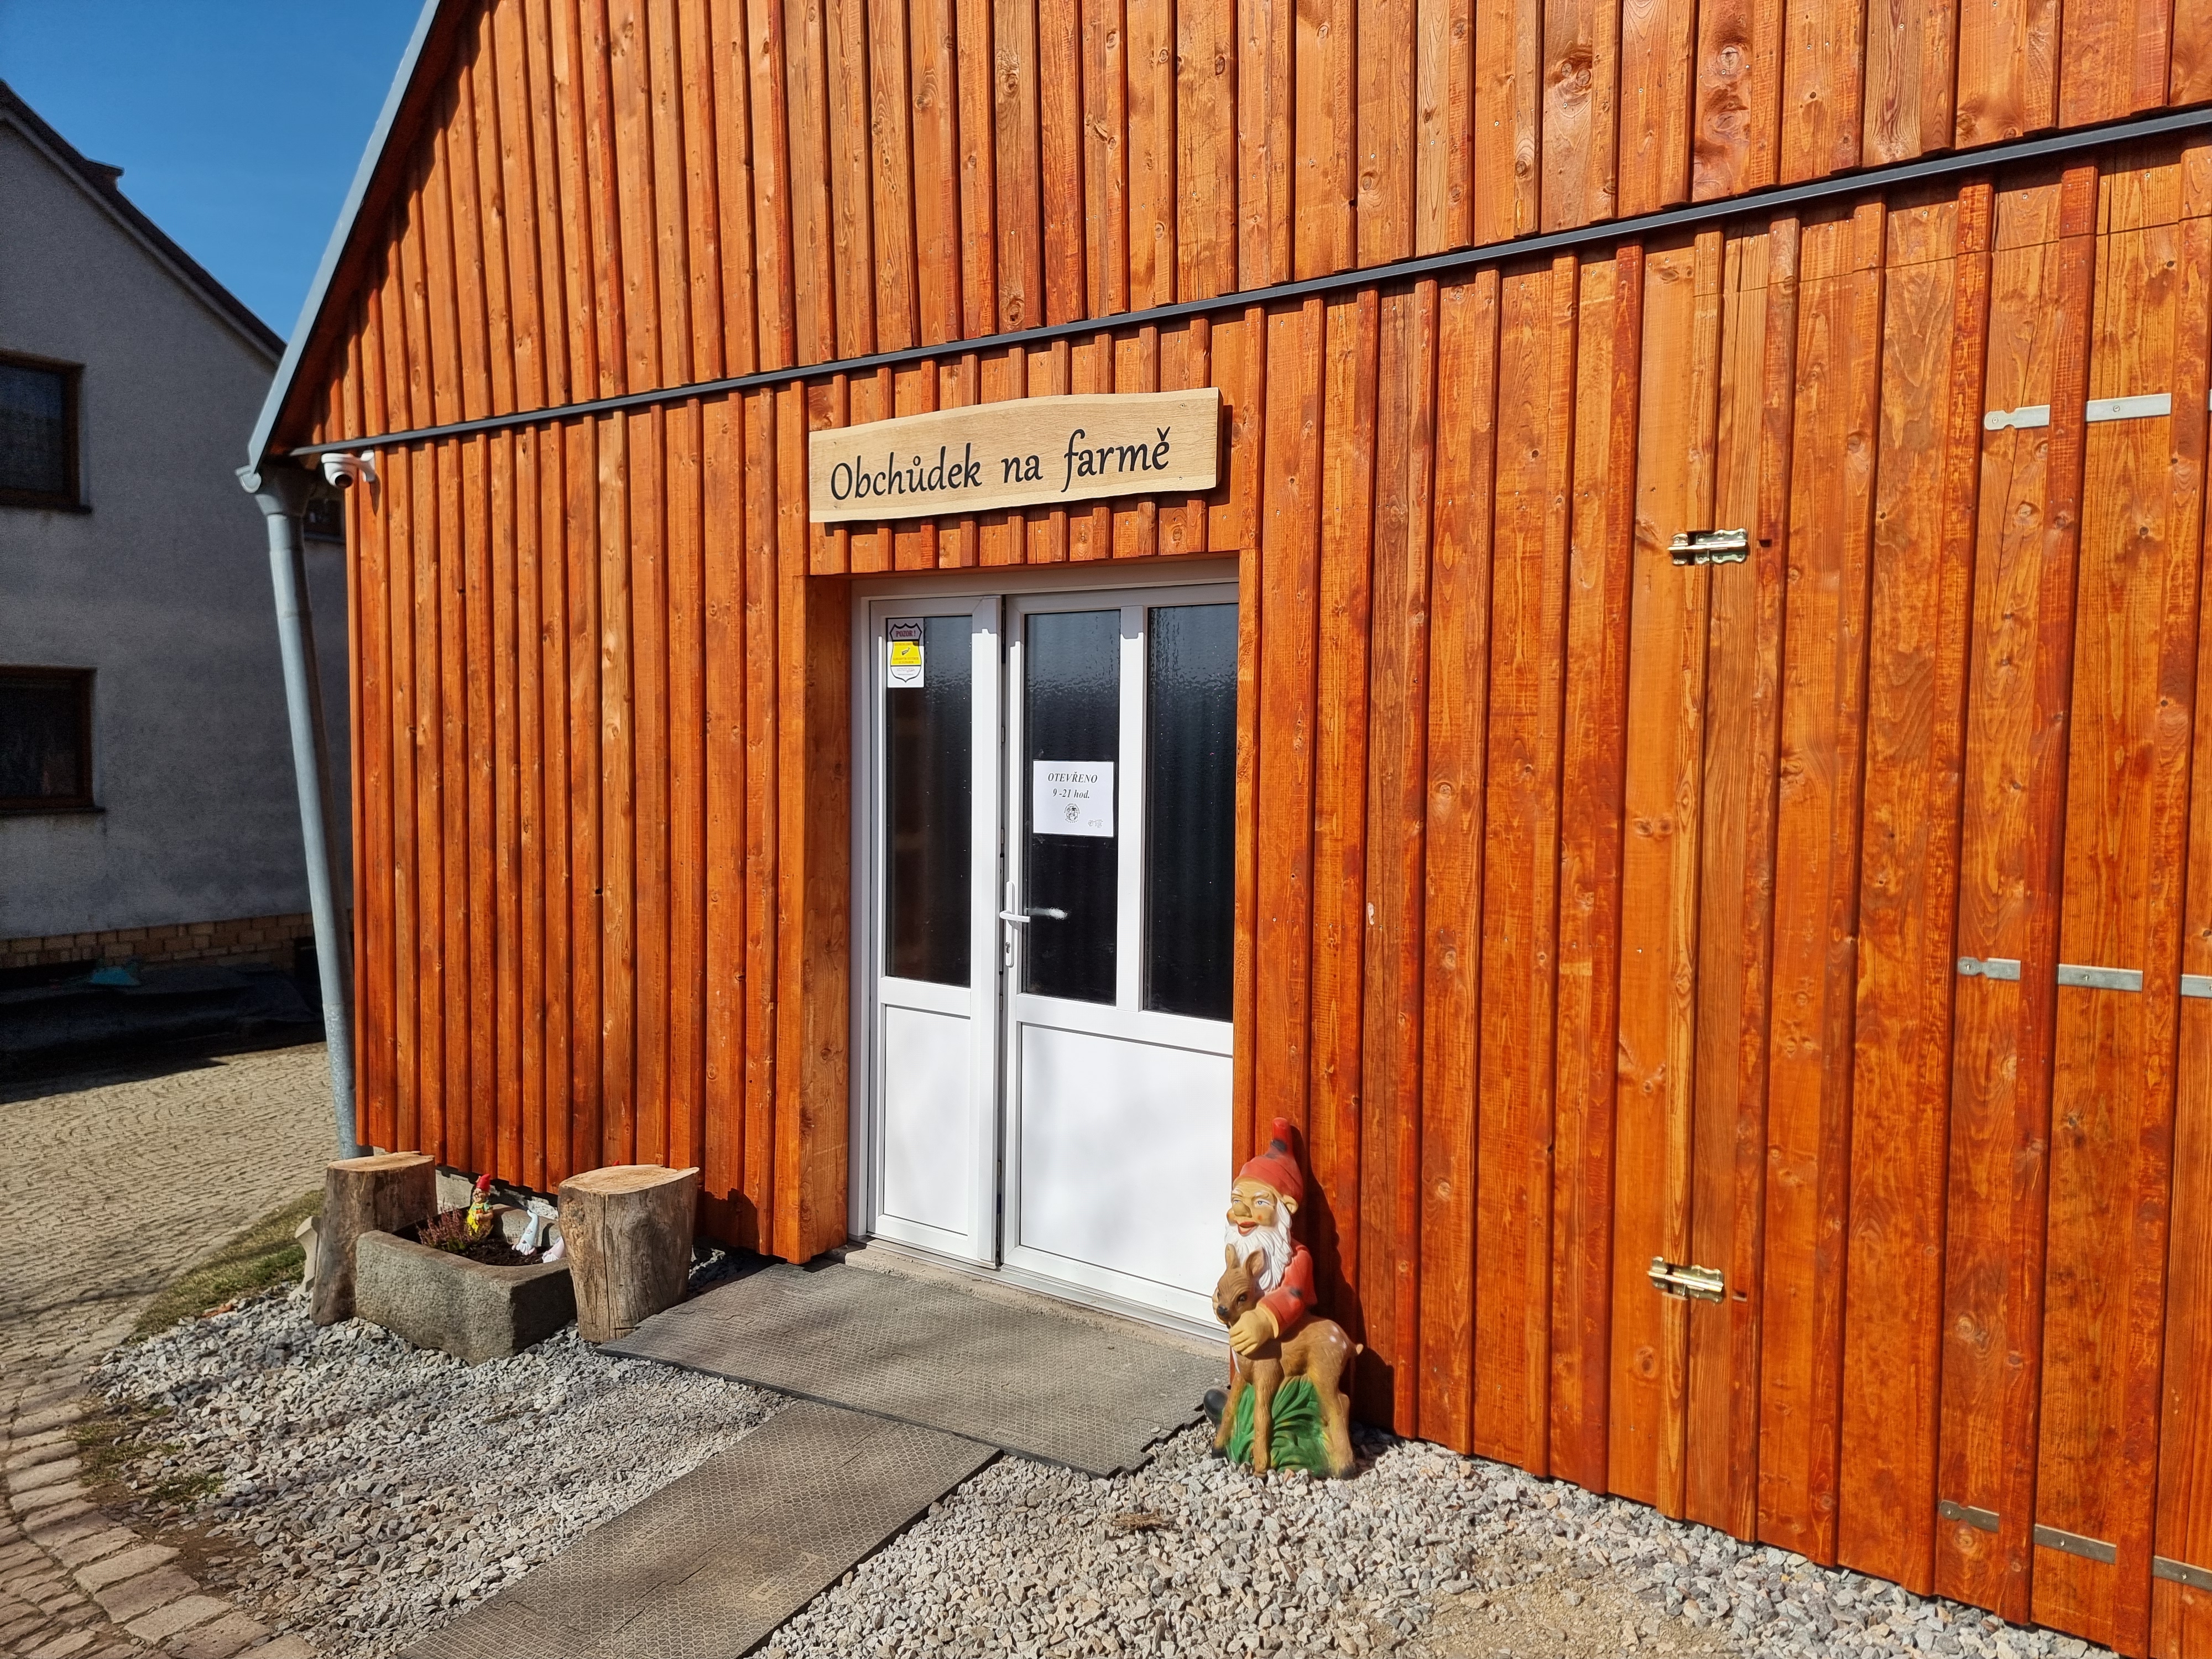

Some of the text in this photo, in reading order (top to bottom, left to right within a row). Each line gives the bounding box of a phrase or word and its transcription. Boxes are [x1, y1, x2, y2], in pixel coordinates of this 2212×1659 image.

[831, 426, 1171, 500] Obchůdek na farmě
[1048, 771, 1098, 783] OTEVŘENO
[1073, 789, 1090, 799] hod.
